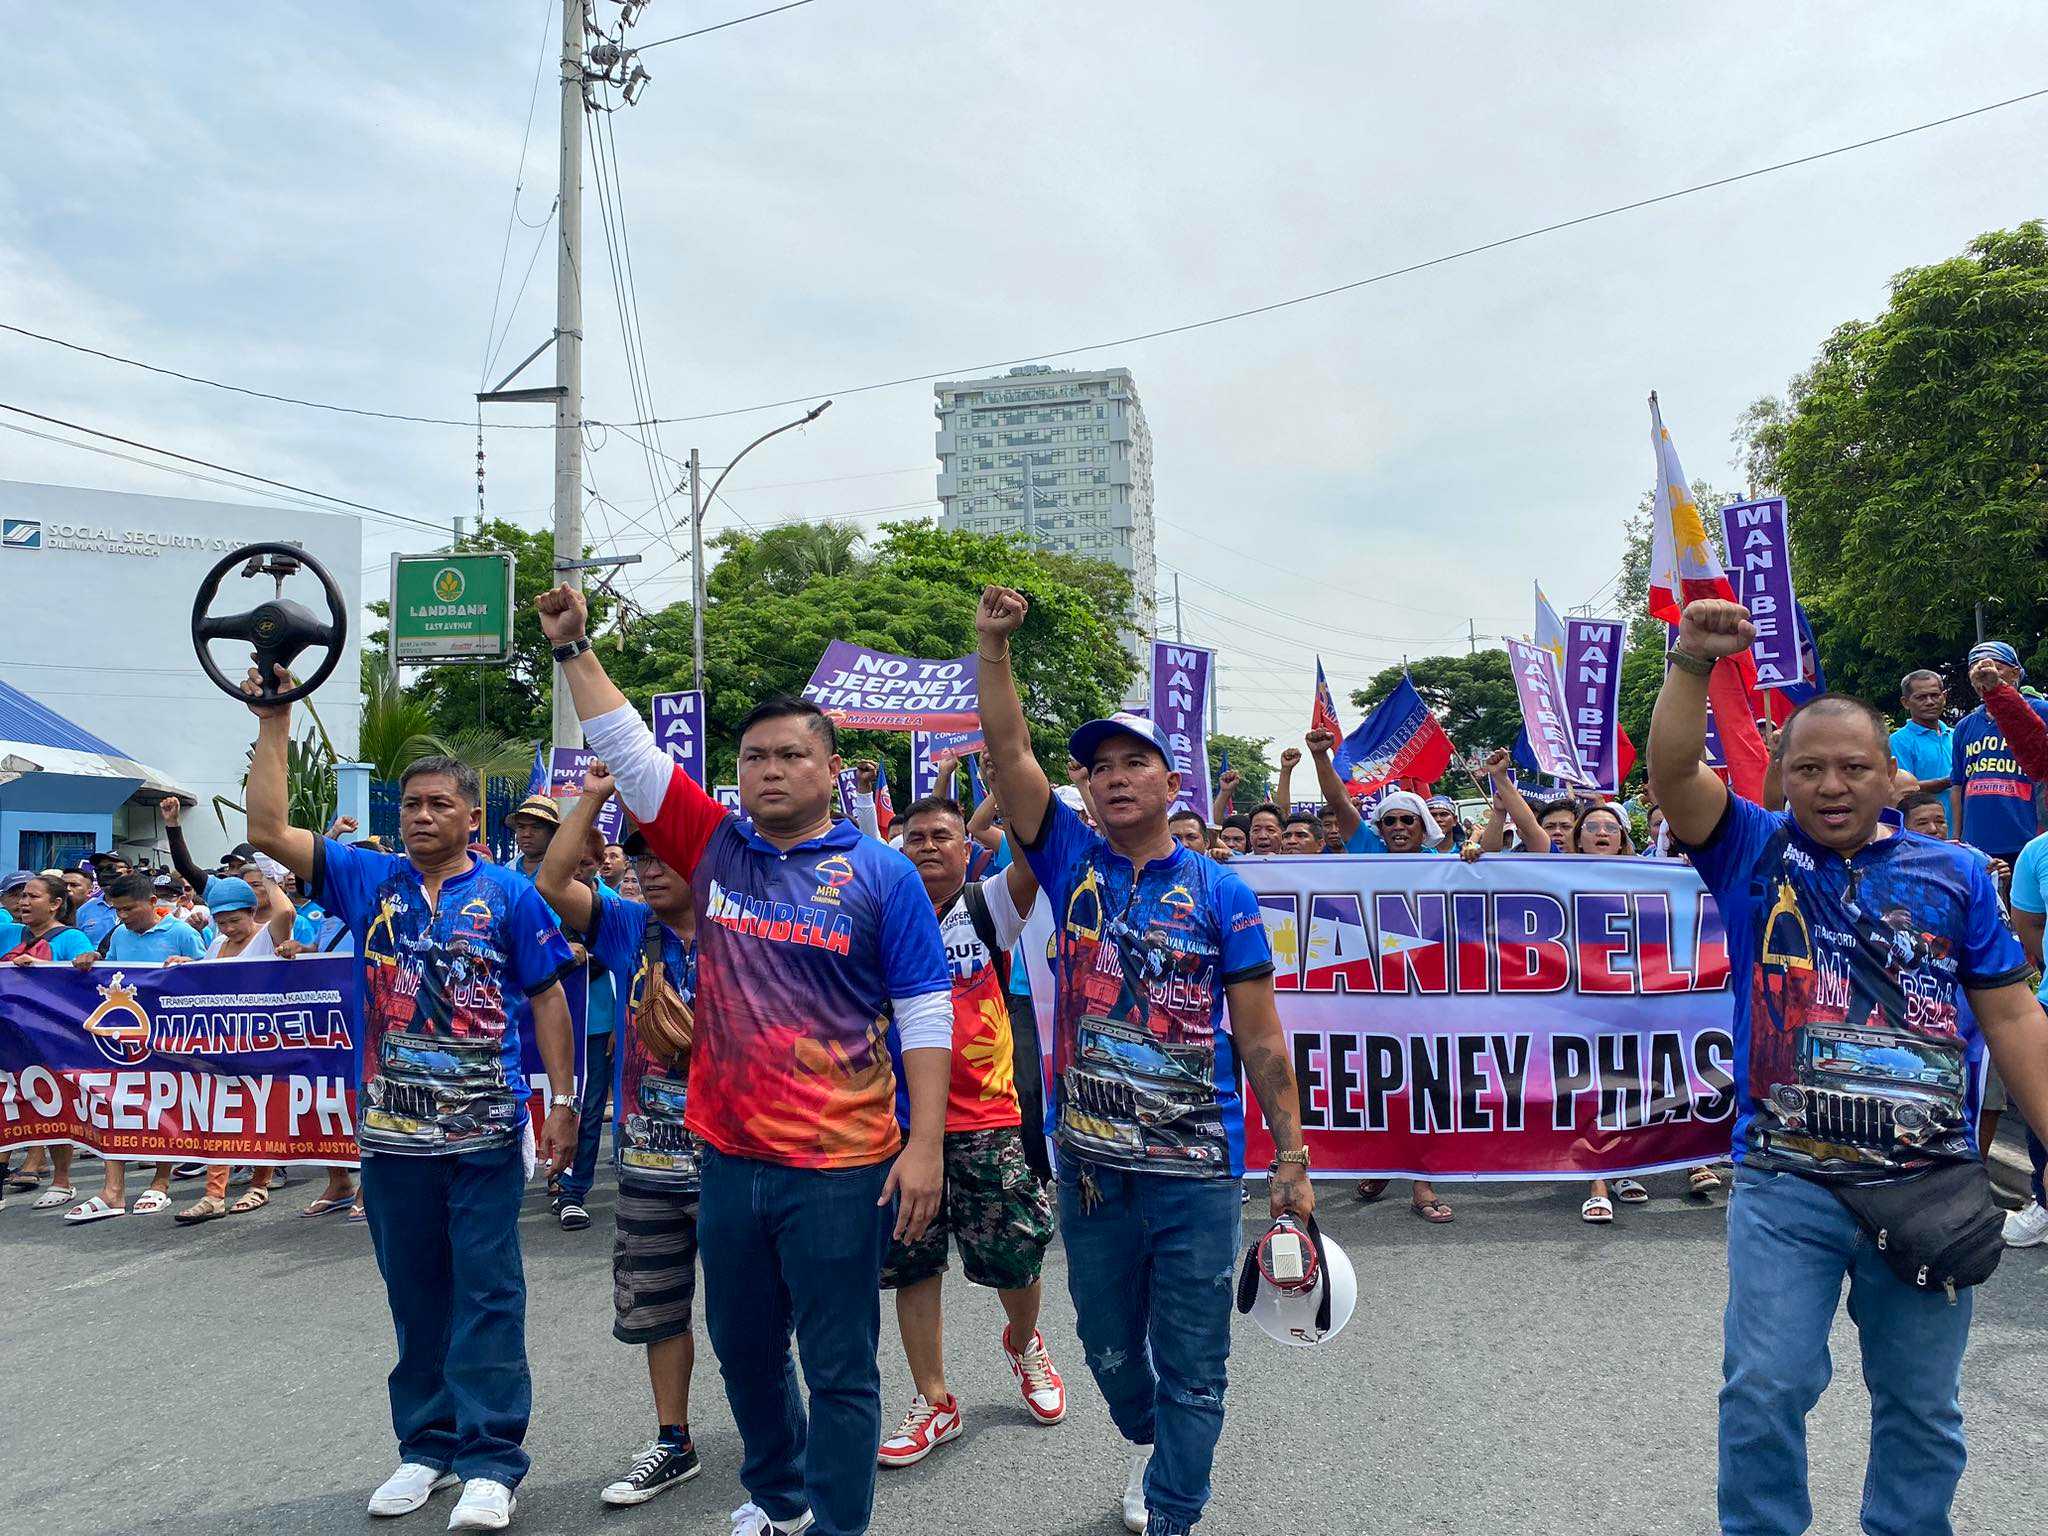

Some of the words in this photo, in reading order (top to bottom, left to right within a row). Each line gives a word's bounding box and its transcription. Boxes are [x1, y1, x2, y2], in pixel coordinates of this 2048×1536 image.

[48, 524, 118, 542] SOCIAL
[123, 529, 210, 550] SECURITY
[107, 542, 160, 557] BRANCH
[1736, 504, 1785, 682] MANIBELA
[410, 604, 488, 616] LANDBANK
[425, 622, 443, 631] EAST
[443, 621, 473, 630] AVENUE
[853, 654, 908, 678] NO
[918, 663, 963, 679] TO
[824, 669, 974, 695] JEEPNEY
[847, 715, 924, 726] MANIBELA
[1517, 644, 1581, 779] MANIBELA
[1965, 740, 1981, 758] NO
[1982, 735, 1998, 751] TO
[554, 768, 577, 778] PUV
[705, 878, 853, 957] MANIBELA
[153, 1010, 354, 1054] MANIBELA
[1262, 1030, 1531, 1134] EEPNEY
[63, 1071, 273, 1135] JEEPNEY
[4, 1124, 32, 1138] FOR
[35, 1122, 67, 1134] FOOD
[113, 1136, 138, 1148] BEG
[142, 1137, 166, 1148] FOR
[203, 1138, 251, 1152] DEPRIVE
[253, 1140, 263, 1152] A
[265, 1141, 287, 1154] MAN
[287, 1142, 315, 1154] FOR
[318, 1142, 361, 1155] JUSTIC
